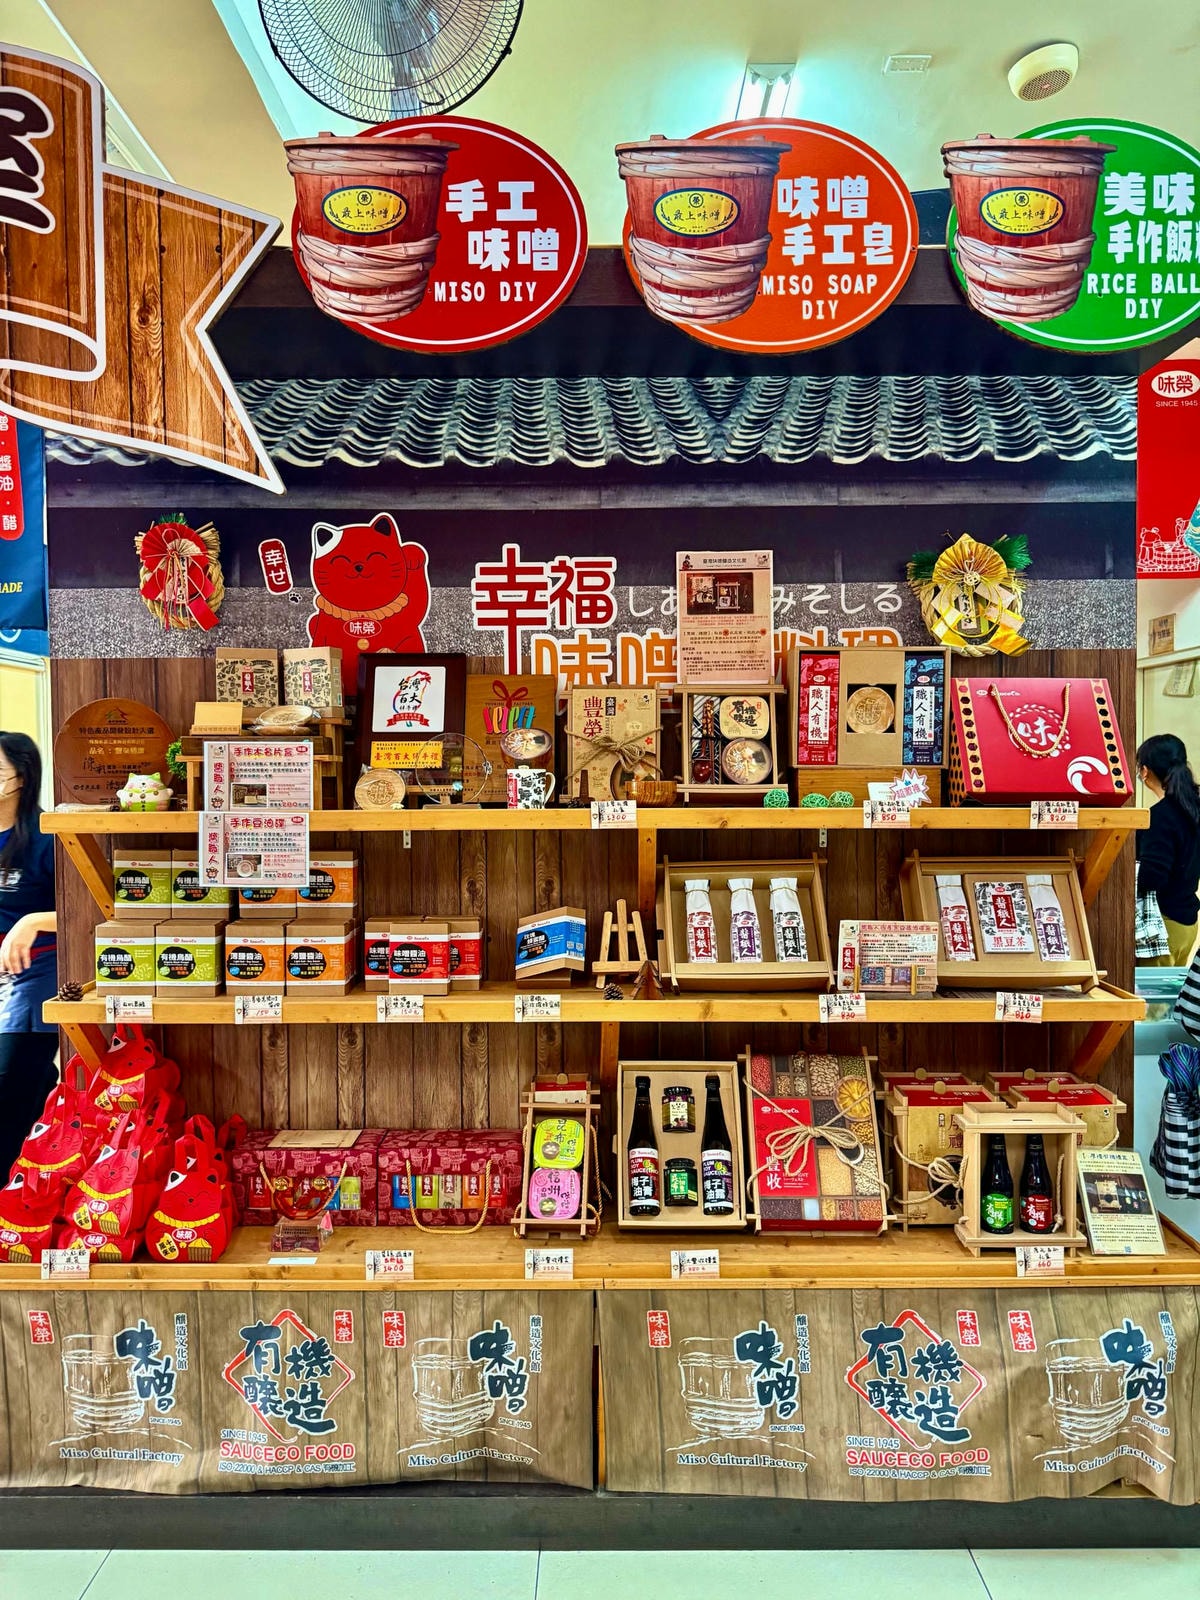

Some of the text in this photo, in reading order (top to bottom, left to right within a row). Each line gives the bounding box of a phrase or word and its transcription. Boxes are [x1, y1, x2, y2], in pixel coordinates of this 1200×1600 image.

[446, 179, 538, 223] 手工
[777, 175, 869, 220] 味噌
[1104, 172, 1196, 216] 美味
[341, 207, 389, 220] 最上味噌
[673, 208, 721, 223] 最上味噌
[998, 208, 1046, 223] 最上味噌
[468, 227, 560, 272] 味噌
[782, 222, 894, 266] 手工皂
[1107, 220, 1200, 264] 手作飯
[434, 281, 537, 302] MISO DIY
[762, 273, 878, 296] MISO SOAP
[1087, 273, 1137, 294] RICE
[802, 300, 839, 320] DIY
[1125, 298, 1163, 319] DIY
[1157, 375, 1194, 394] 味榮
[1155, 400, 1198, 408] SINCE 1945
[264, 549, 287, 586] 幸せ
[472, 544, 616, 676] 幸福
[349, 621, 376, 635] 味榮
[399, 691, 422, 704] 百大
[810, 687, 824, 739] 職人有機
[583, 695, 604, 738] 豐榮
[915, 688, 929, 740] 職人有機
[993, 936, 1026, 947] 黑豆茶
[554, 1119, 568, 1143] 昆布
[547, 1171, 561, 1197] 信州
[30, 1312, 51, 1342] 味榮
[174, 1313, 189, 1371] 釀造文化館
[335, 1311, 352, 1342] 味榮
[384, 1312, 405, 1347] 味榮
[649, 1311, 669, 1346] 味榮
[958, 1311, 979, 1345] 味榮
[1010, 1312, 1034, 1350] 味榮
[1158, 1311, 1177, 1374] 釀造文化館
[240, 1320, 336, 1380] 有機
[530, 1315, 543, 1373] 釀造文化館
[795, 1314, 811, 1373] 釀造文化館
[861, 1322, 964, 1384] 有機
[114, 1319, 177, 1413] 味噌
[468, 1320, 530, 1414] 味噌
[734, 1321, 800, 1419] 味噌
[1100, 1318, 1166, 1419] 味噌
[242, 1374, 338, 1435] 釀造
[866, 1377, 972, 1443] 釀造
[220, 1442, 355, 1462] SAUCECO FOOD
[221, 1429, 268, 1443] SINCE 1945
[846, 1436, 900, 1448] SINCE 1945
[60, 1447, 184, 1467] Miso Cultural Factory
[219, 1463, 232, 1472] ISO
[233, 1463, 256, 1473] 22000
[265, 1465, 294, 1474] HACCP
[304, 1463, 321, 1473] CAS
[408, 1448, 534, 1467] Miso Cultural Factory
[677, 1452, 808, 1472] Miso Cultural Factory
[846, 1448, 989, 1468] SAUCECO FOOD
[850, 1467, 863, 1477] ISO
[866, 1468, 890, 1478] 22000
[900, 1469, 929, 1479] HACCP
[939, 1468, 956, 1478] CAS
[1044, 1445, 1167, 1473] Miso Cultural Factory
